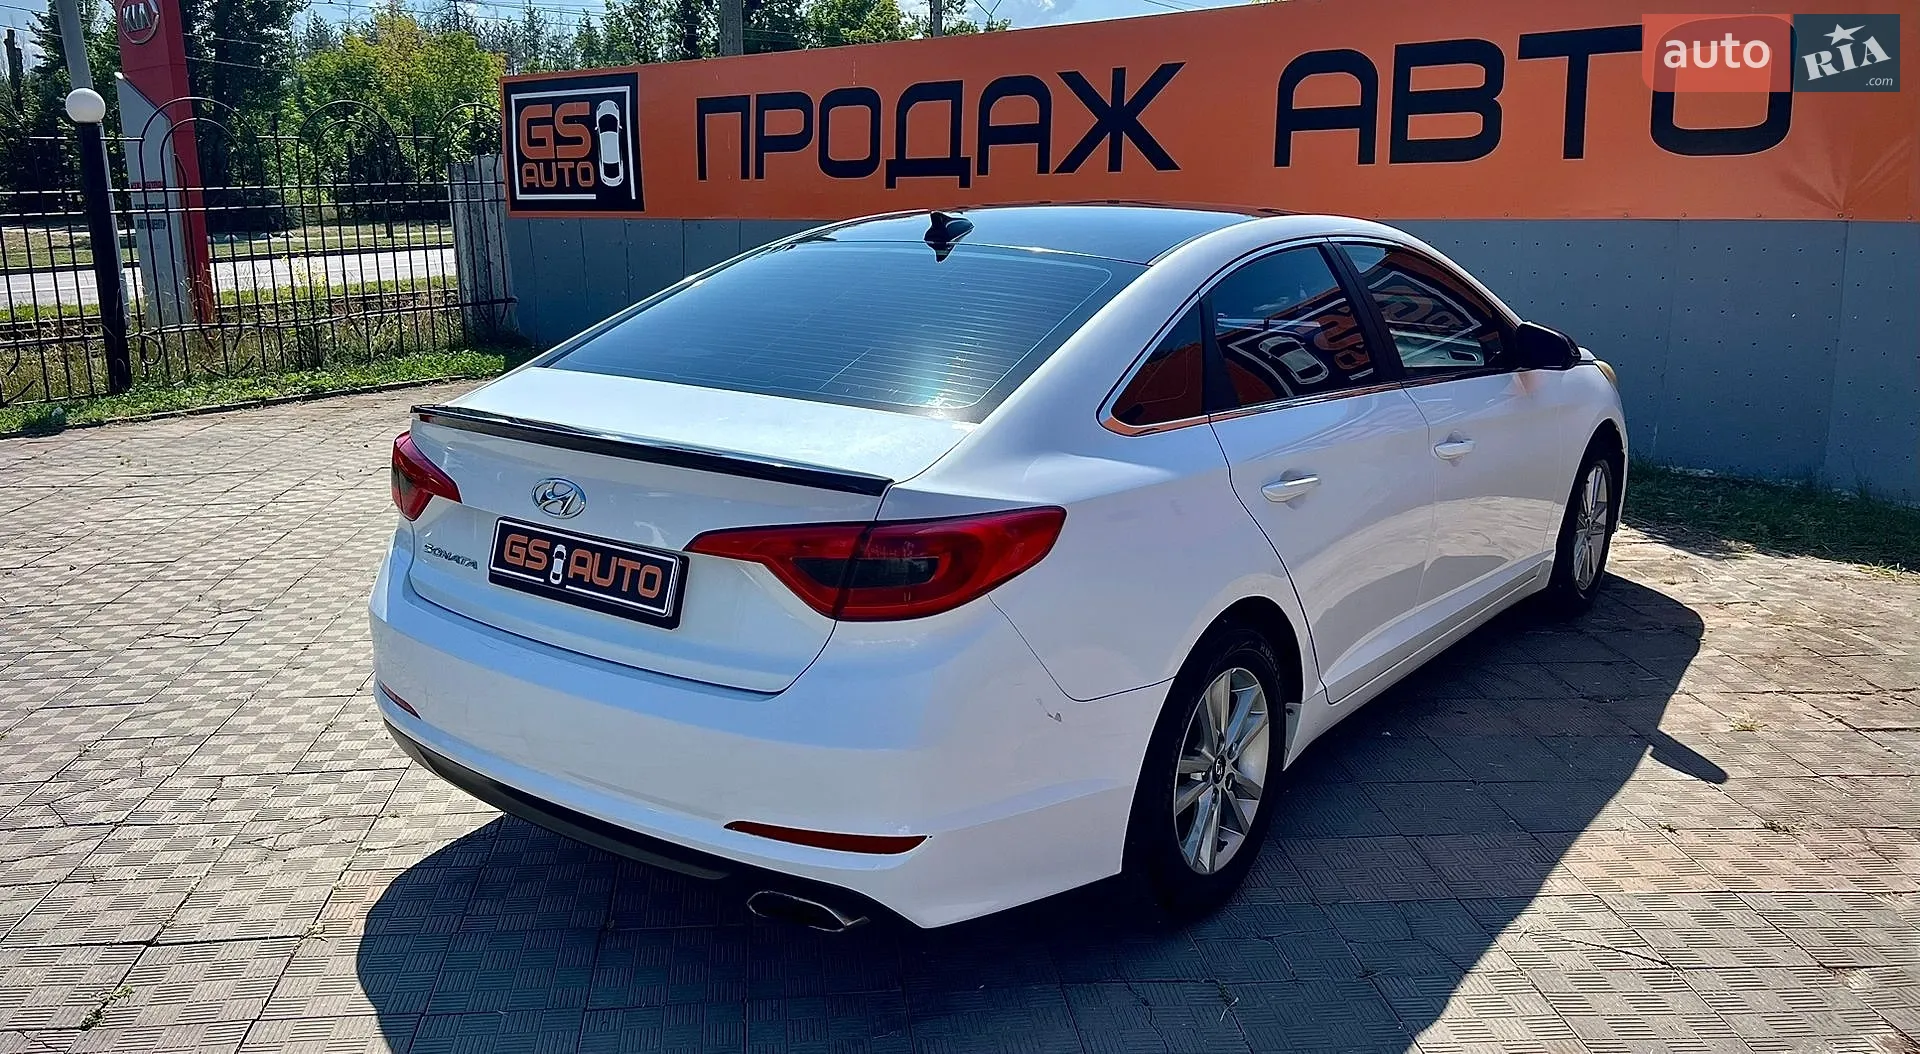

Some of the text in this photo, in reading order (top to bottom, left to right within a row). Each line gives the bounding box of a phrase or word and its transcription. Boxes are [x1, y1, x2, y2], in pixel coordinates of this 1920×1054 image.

[123, 2, 151, 33] KIA
[695, 15, 1798, 190] ПРОДАЖ АВТО
[519, 101, 592, 160] GS
[521, 161, 595, 188] AUTO
[137, 218, 166, 231] АВТЦЕНТР
[424, 543, 478, 570] SONATA
[504, 533, 662, 599] GS AUTO
